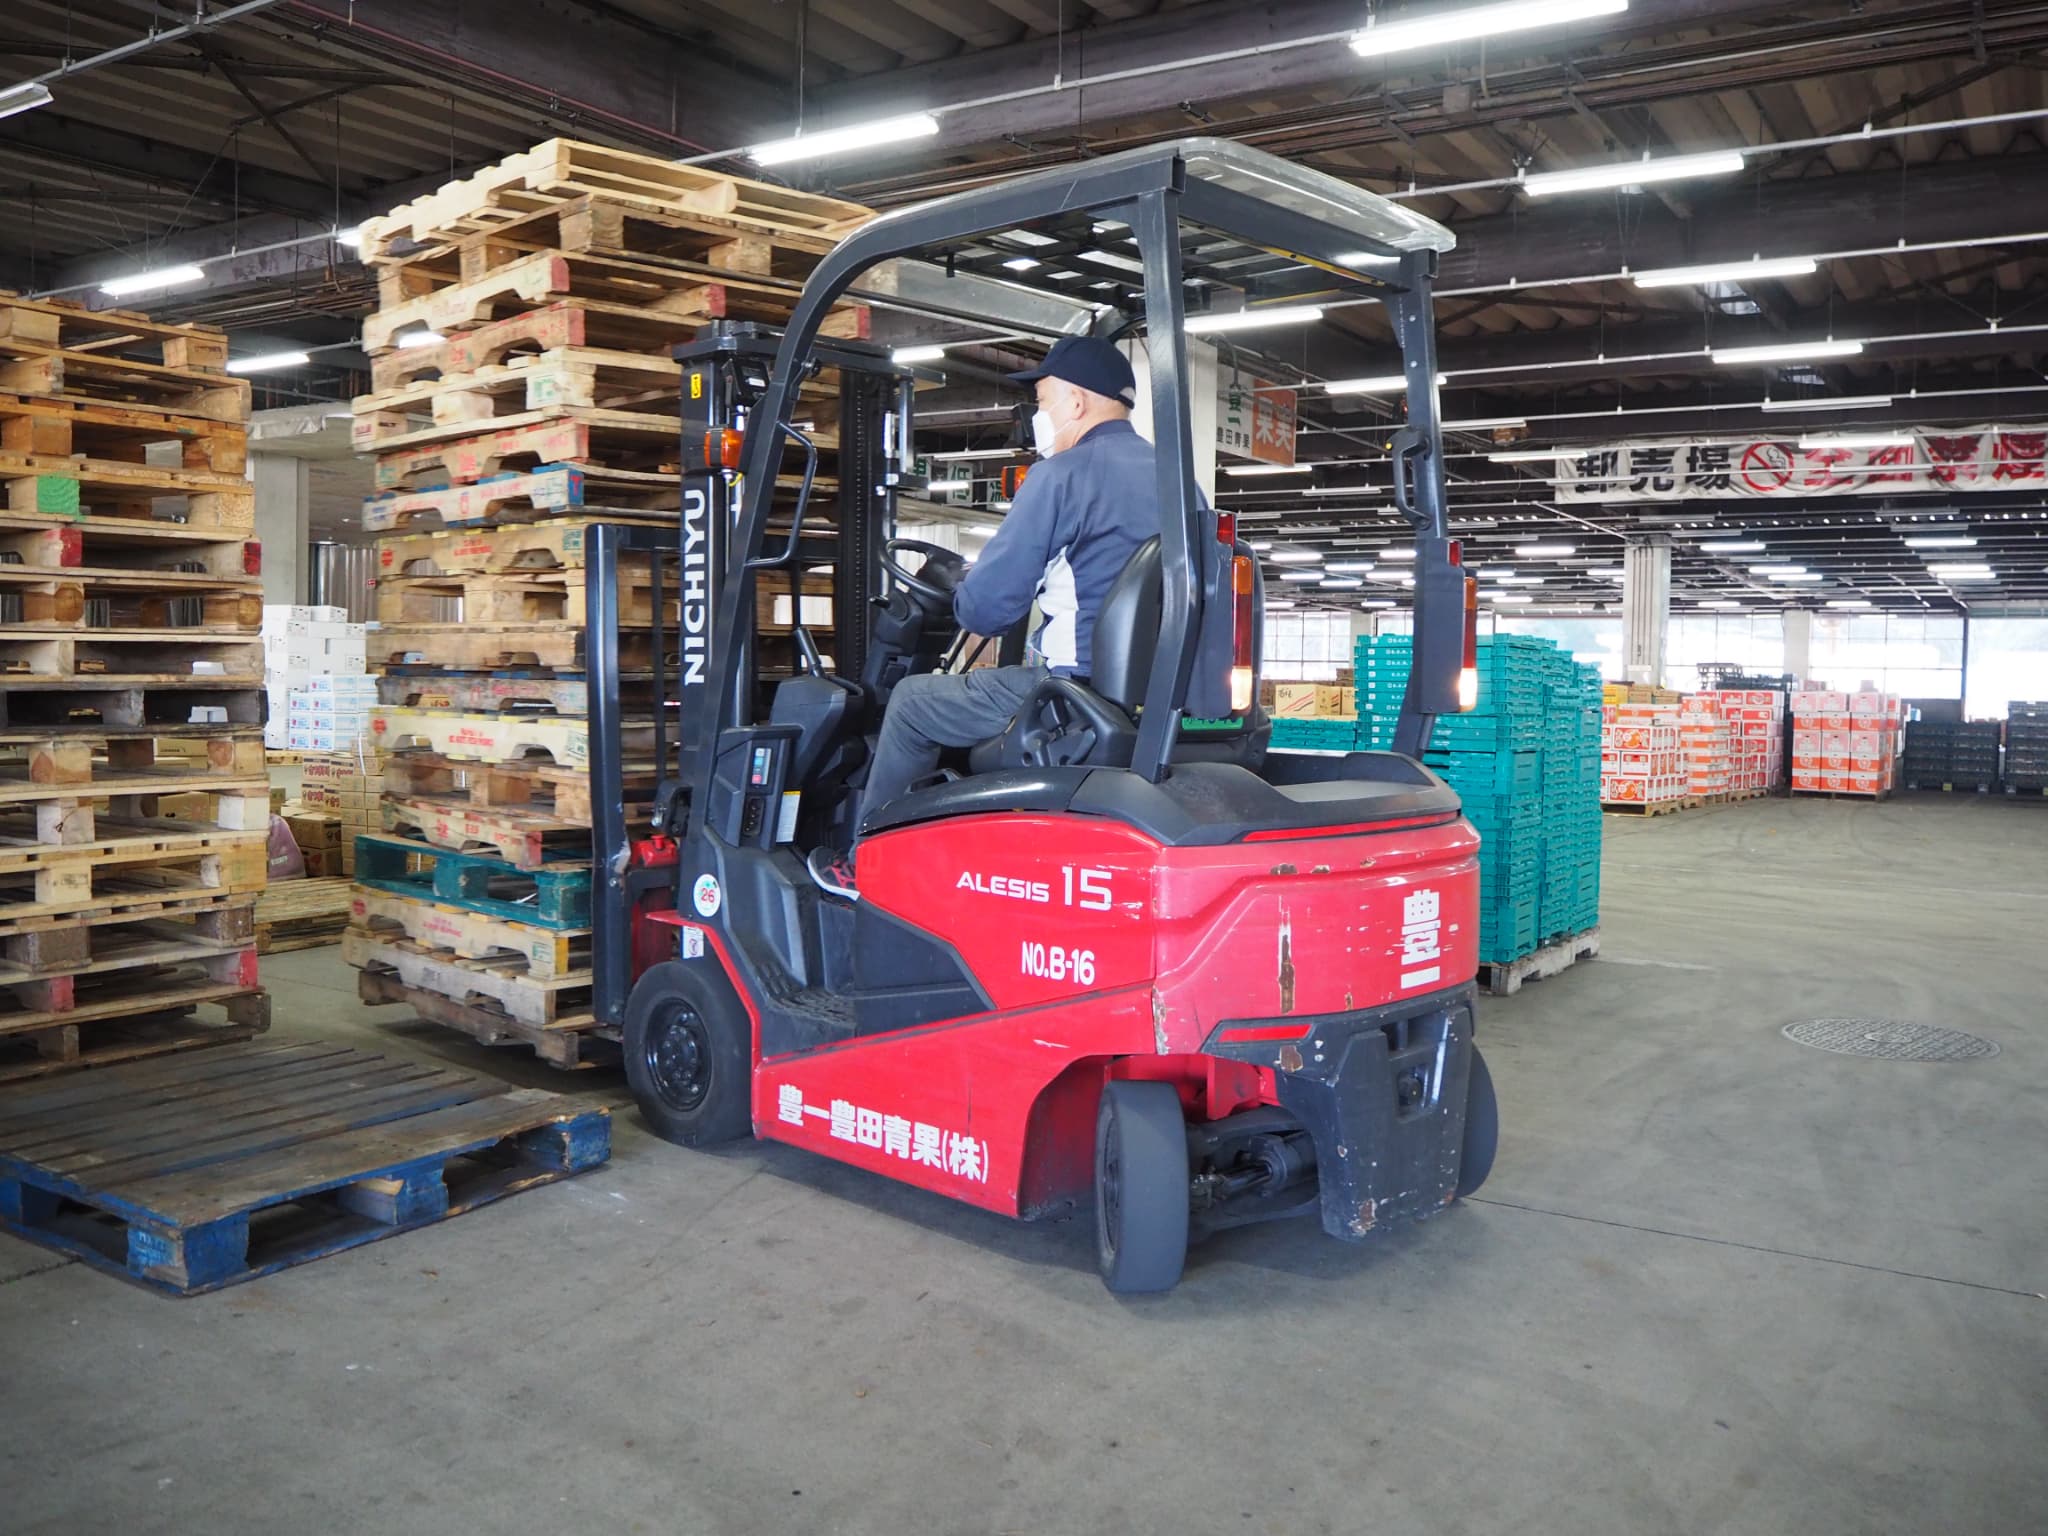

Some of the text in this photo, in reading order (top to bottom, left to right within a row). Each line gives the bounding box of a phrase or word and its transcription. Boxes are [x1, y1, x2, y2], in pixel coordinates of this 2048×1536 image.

[684, 489, 705, 687] NICHIYU
[701, 887, 715, 903] 26
[956, 865, 1112, 911] ALESIS 15
[1021, 940, 1096, 986] NO.B-16
